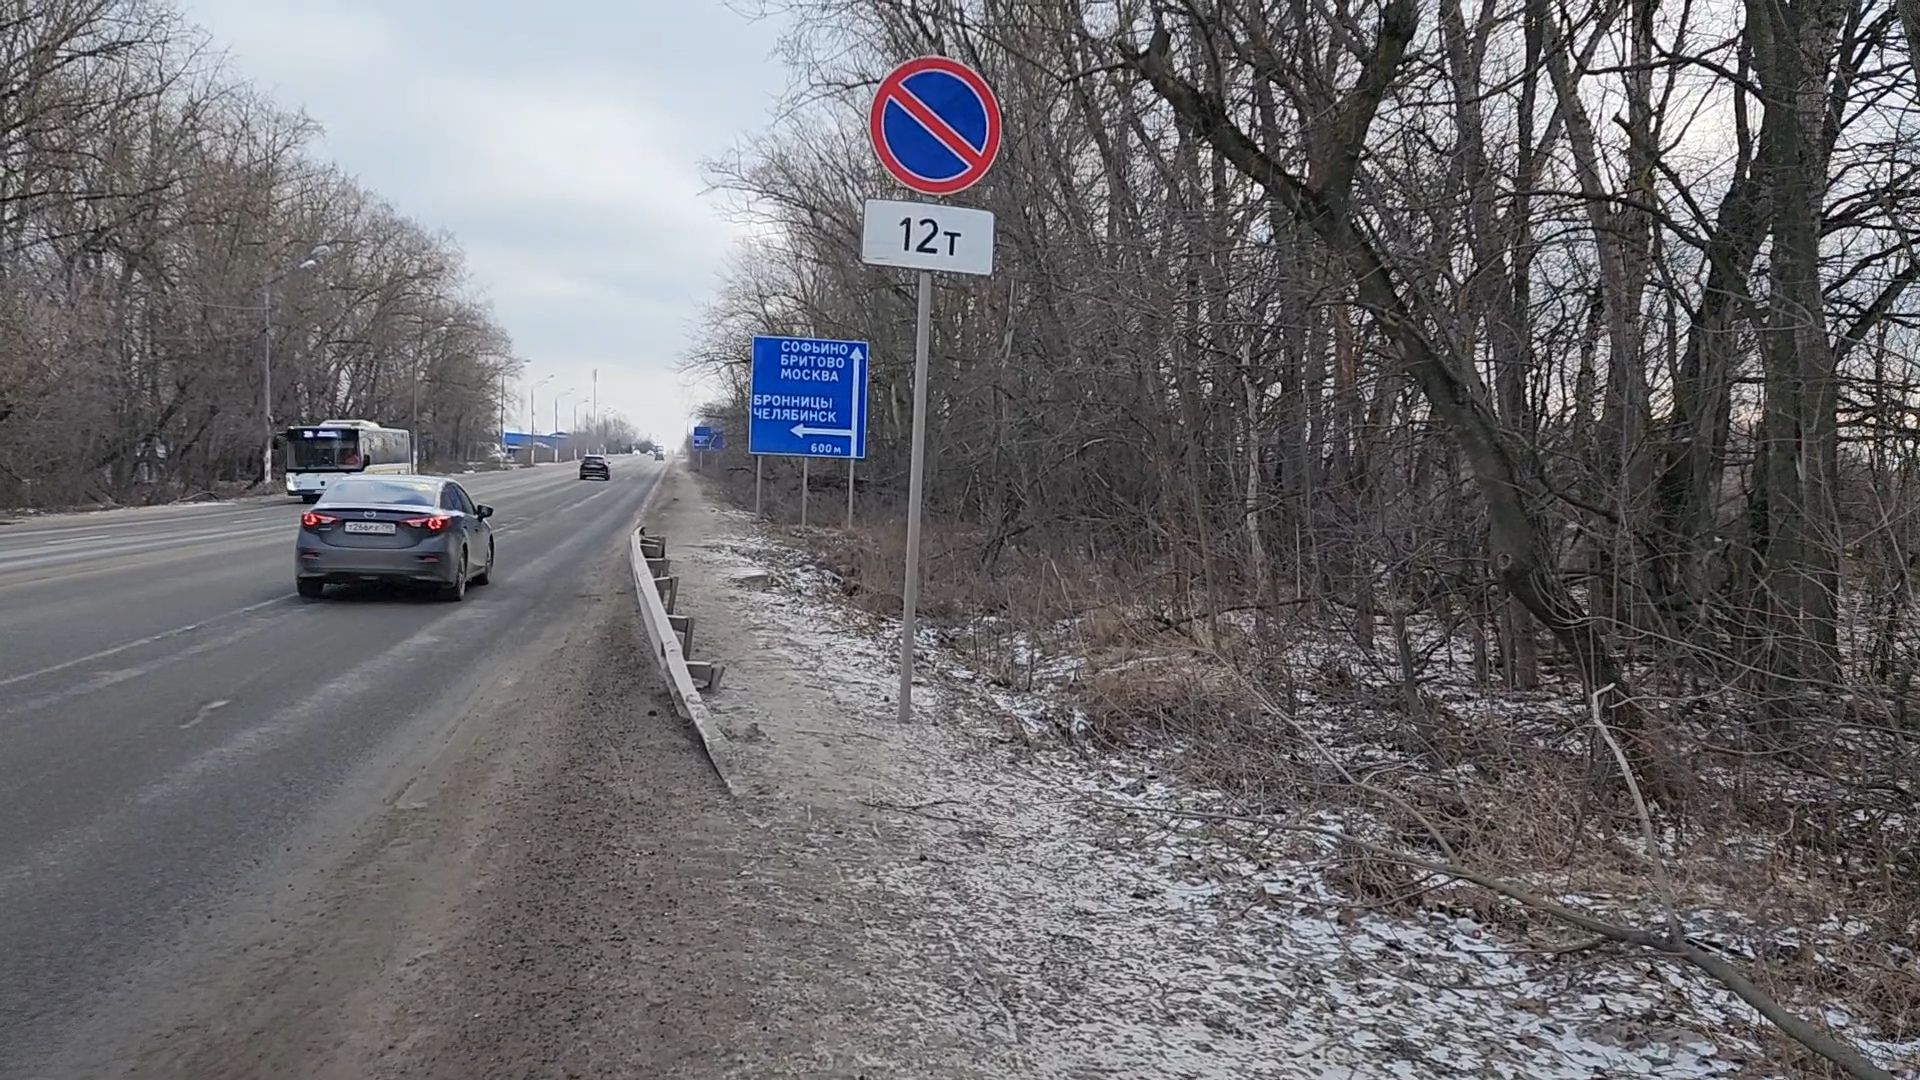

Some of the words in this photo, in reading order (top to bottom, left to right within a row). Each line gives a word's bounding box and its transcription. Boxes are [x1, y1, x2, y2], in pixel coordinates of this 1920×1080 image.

[781, 340, 849, 355] СОФЬИНО
[780, 354, 845, 369] БРИТОВО
[780, 368, 839, 382] МОСКВА
[753, 394, 833, 410] БРОННИЦЫ
[753, 408, 837, 423] ЧЕЛЯБИНСК
